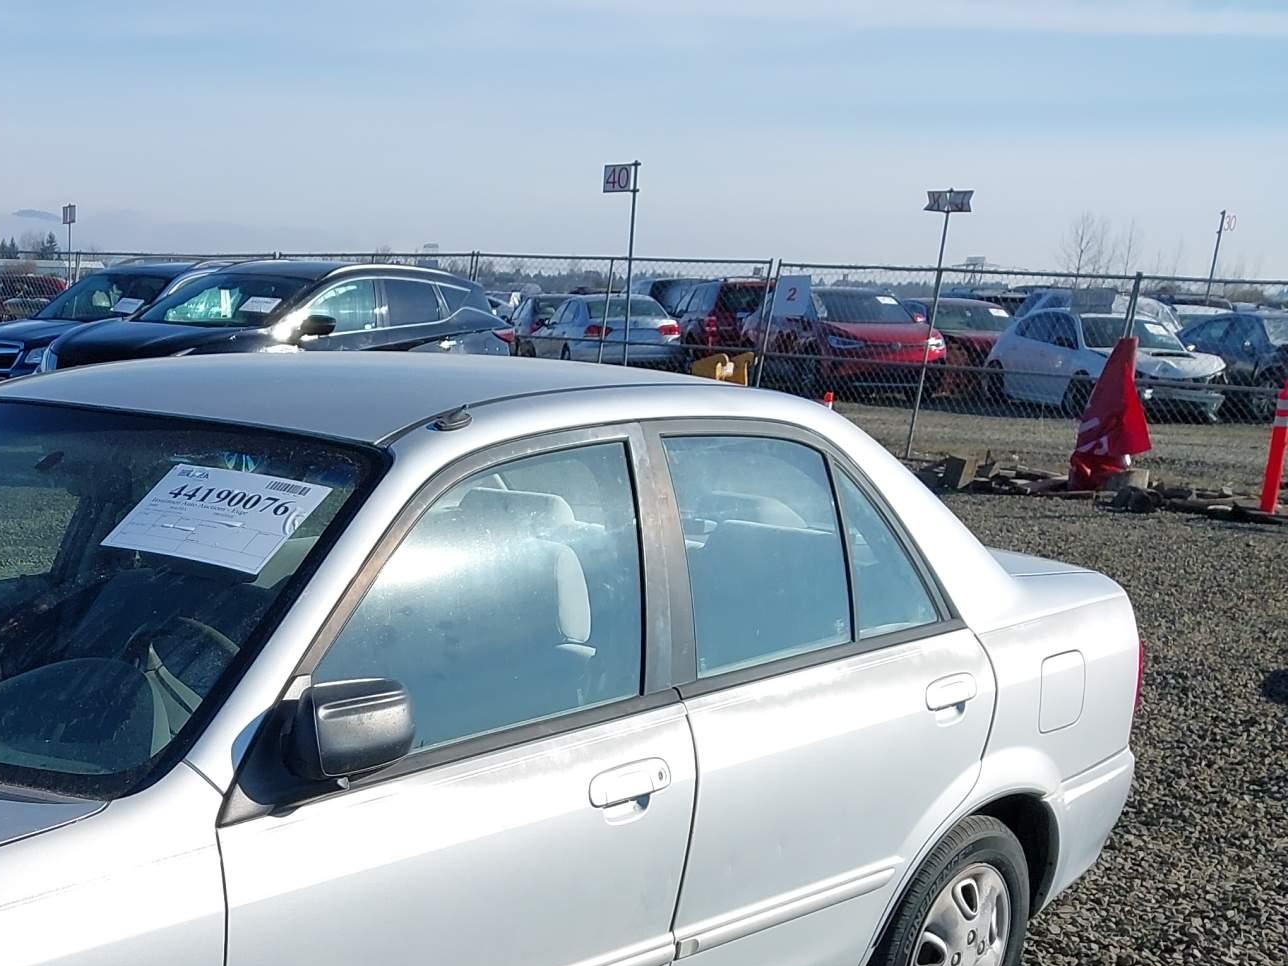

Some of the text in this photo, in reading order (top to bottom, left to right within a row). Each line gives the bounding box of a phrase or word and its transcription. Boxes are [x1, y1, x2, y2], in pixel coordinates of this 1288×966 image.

[606, 167, 629, 189] 40
[1224, 215, 1237, 231] 30
[786, 287, 798, 301] 2
[169, 483, 296, 516] 44190076
